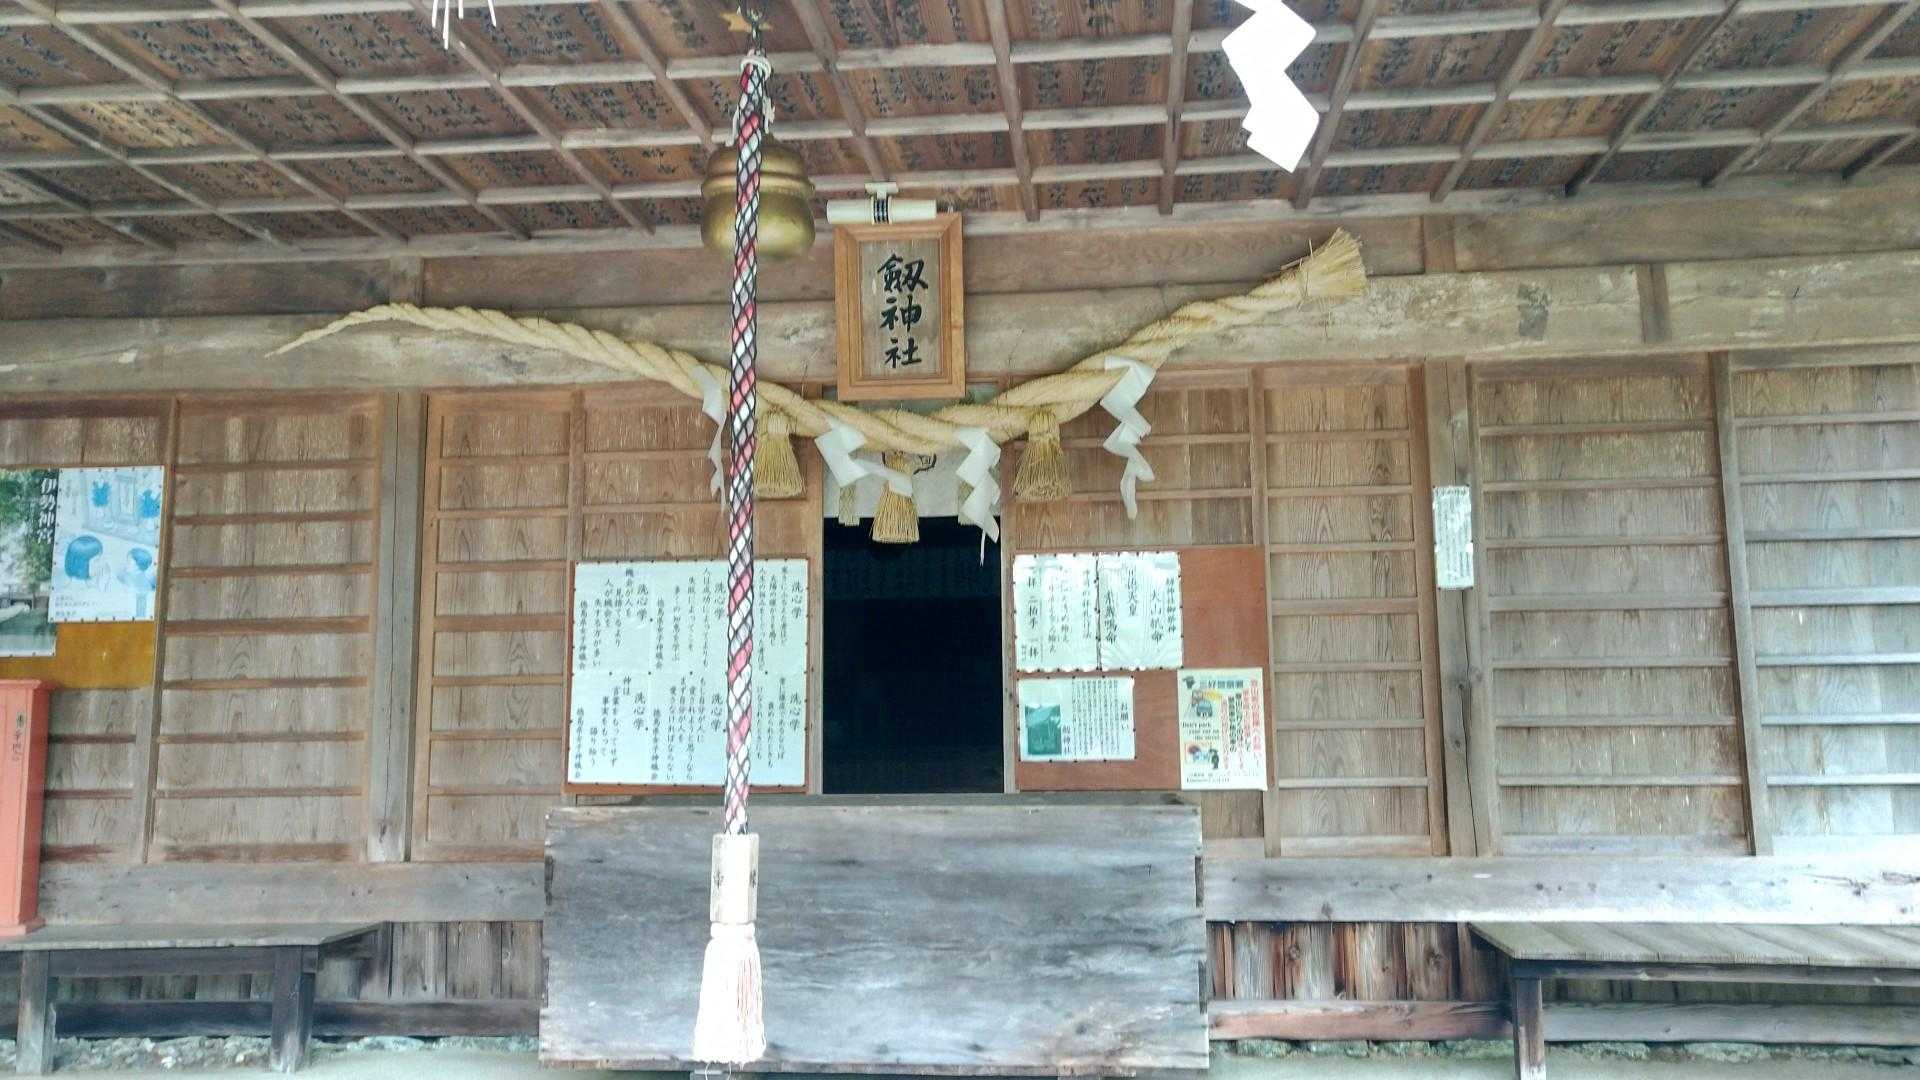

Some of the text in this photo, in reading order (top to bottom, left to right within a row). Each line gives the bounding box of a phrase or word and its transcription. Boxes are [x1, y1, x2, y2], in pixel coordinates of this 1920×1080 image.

[38, 478, 57, 544] 伊勢神宮
[604, 578, 614, 627] 人が機会を
[625, 568, 634, 618] 機会が人を
[637, 584, 649, 621] 洗心学
[714, 581, 726, 619] 洗心学
[792, 580, 803, 619] 洗心学
[623, 676, 631, 695] 神は
[601, 696, 609, 756] 事実をもって
[633, 692, 646, 730] 洗心学
[711, 693, 723, 731] 洗心学
[790, 692, 801, 731] 洗心学
